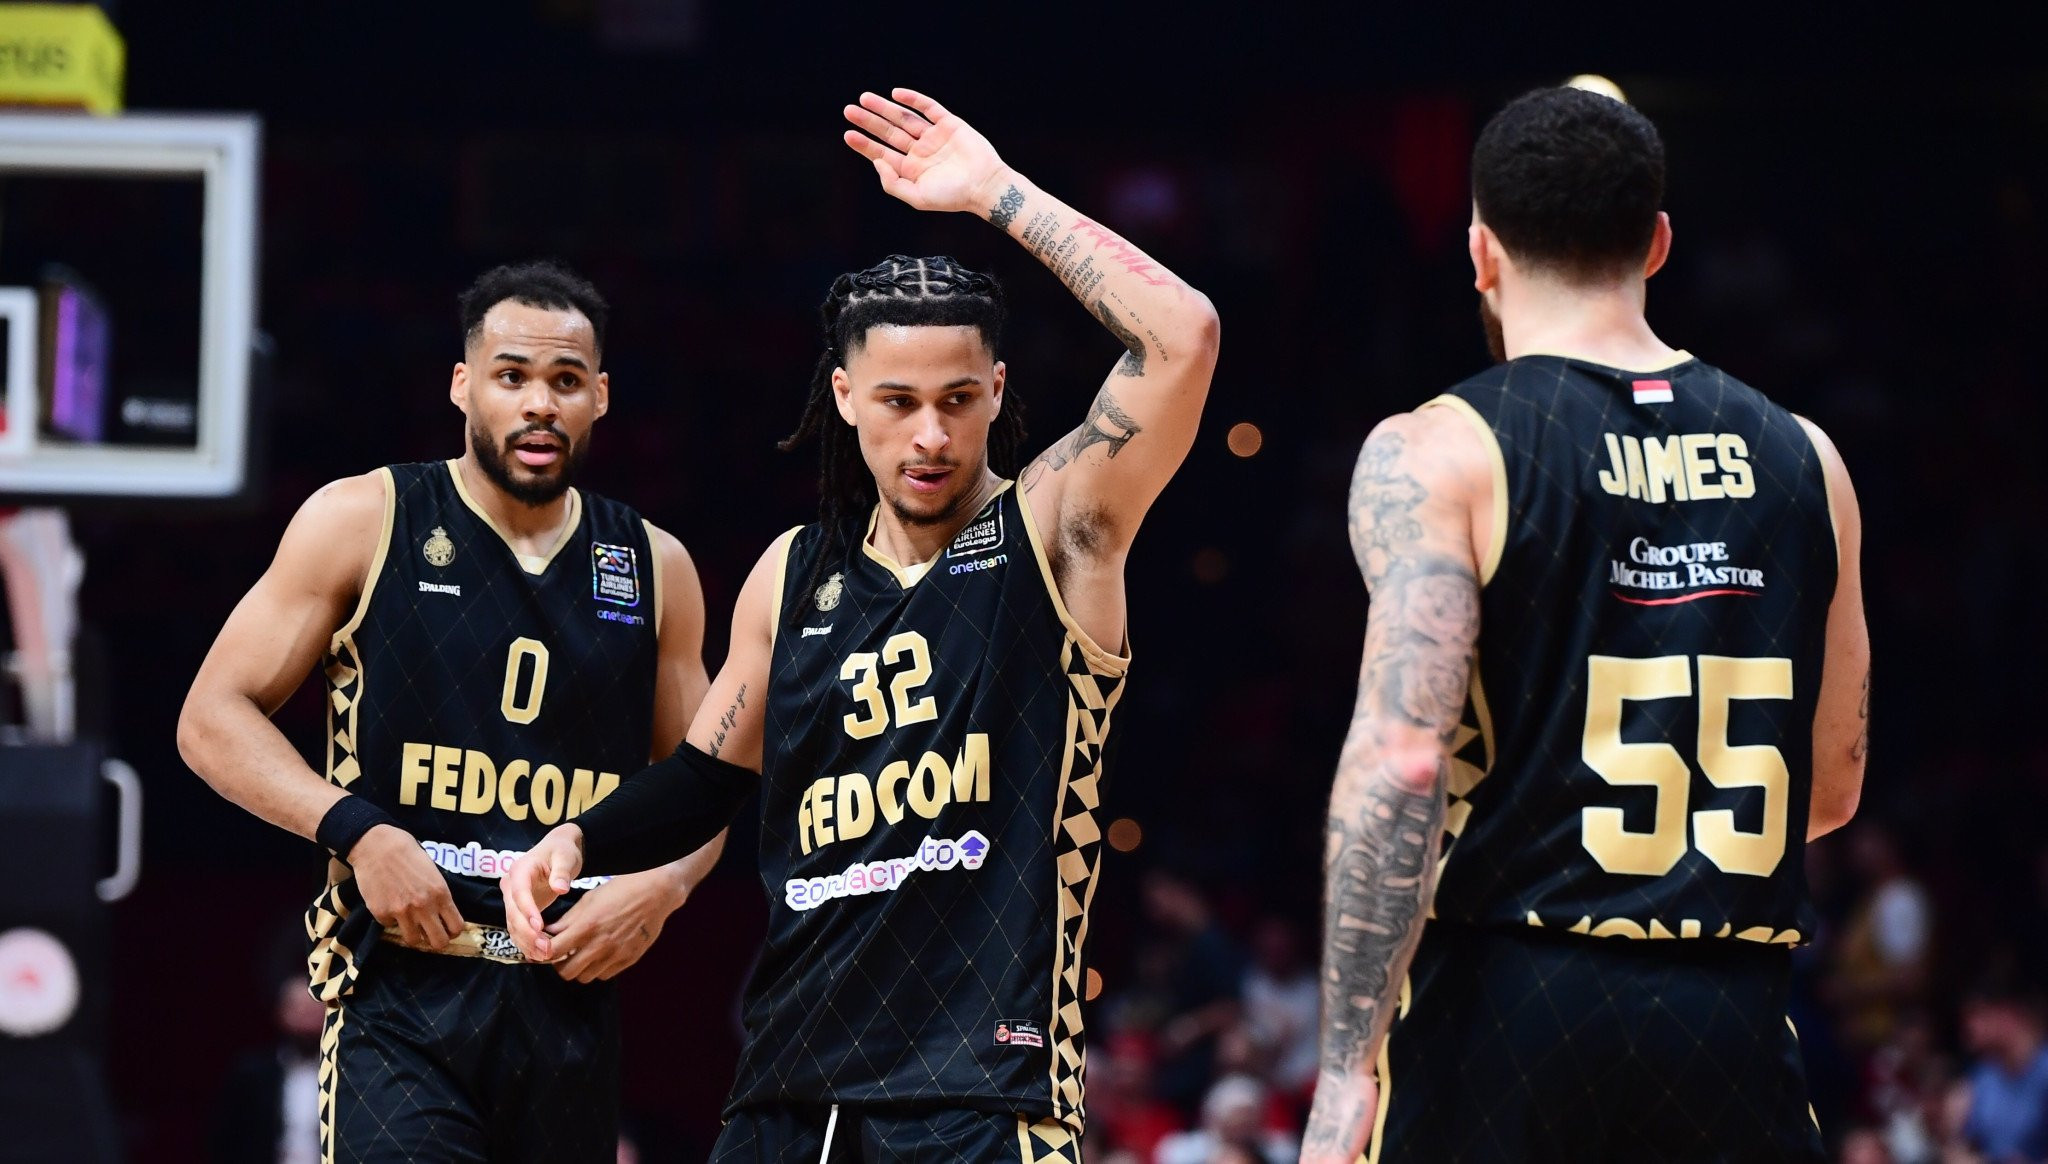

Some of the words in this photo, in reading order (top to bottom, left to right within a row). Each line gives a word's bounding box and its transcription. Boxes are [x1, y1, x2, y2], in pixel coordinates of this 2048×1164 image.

[1598, 433, 1756, 503] JAMES
[955, 528, 996, 543] AIRLINES
[961, 520, 995, 535] URKISH
[419, 581, 461, 597] SPALDING
[949, 554, 1007, 575] oneteam
[597, 610, 644, 626] oneteam
[501, 636, 549, 725] 0
[840, 630, 938, 740] 32
[399, 742, 621, 826] FEDCOM
[798, 733, 991, 857] FEDCOM
[1581, 655, 1794, 878] 55
